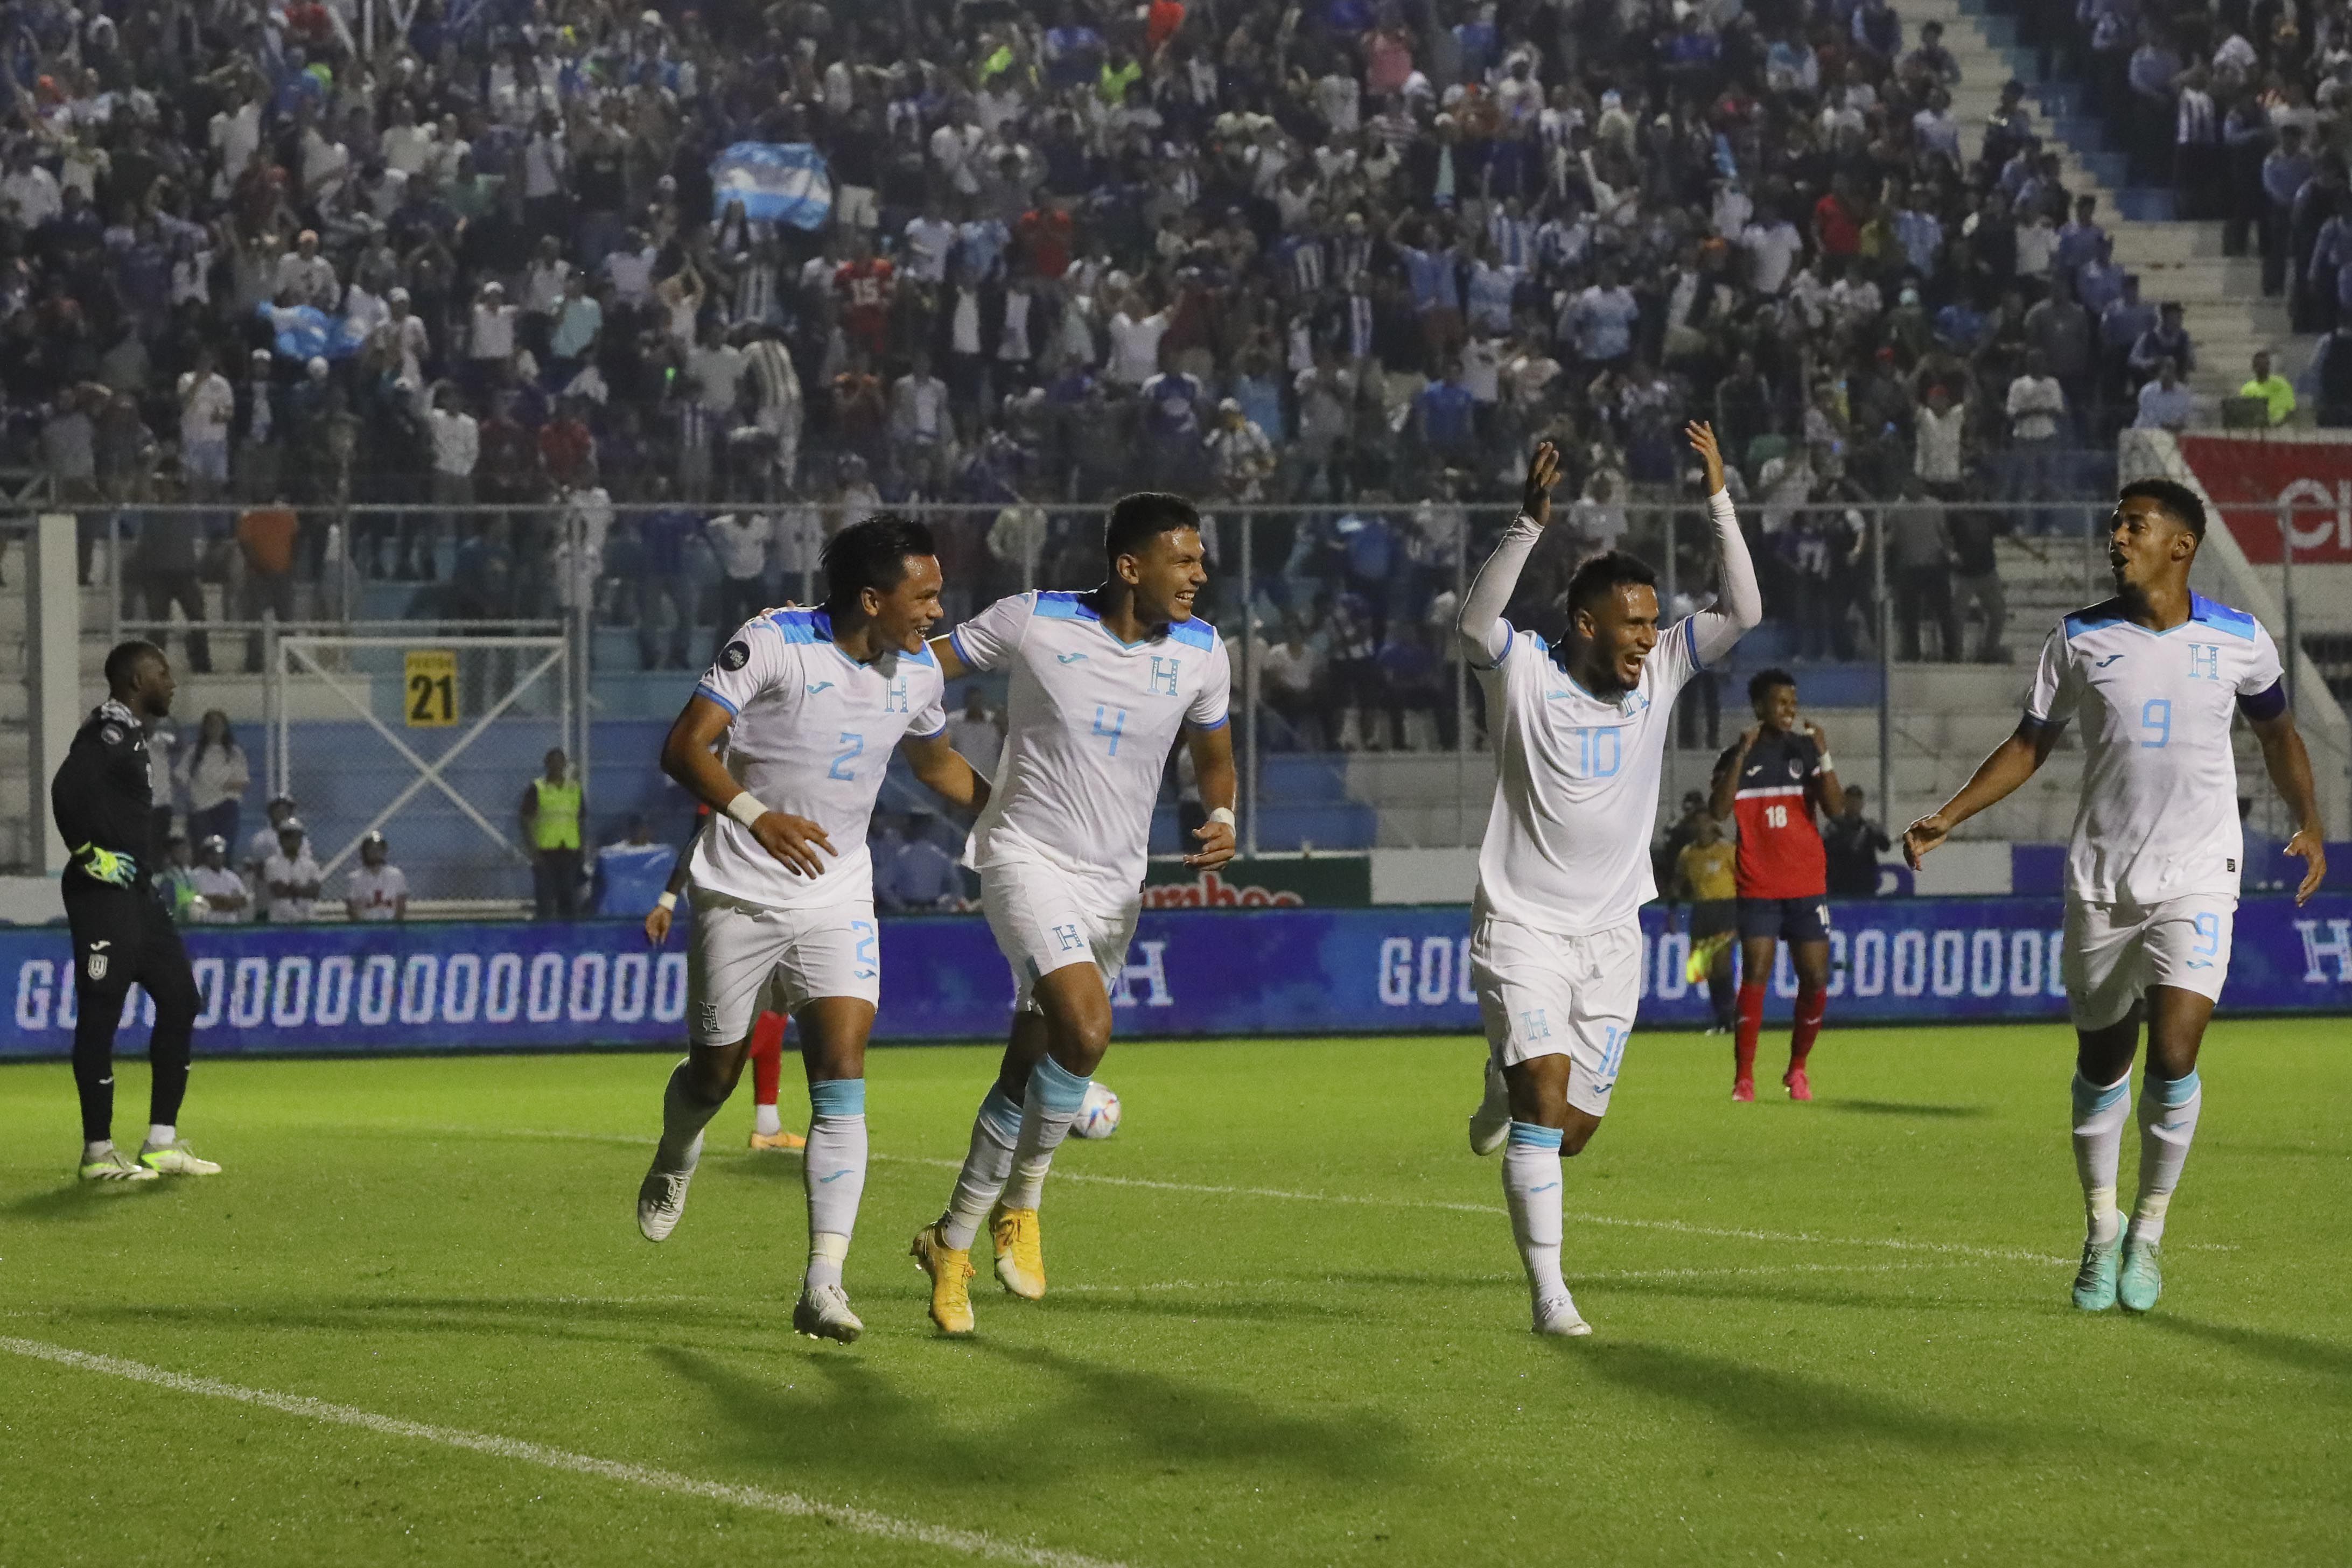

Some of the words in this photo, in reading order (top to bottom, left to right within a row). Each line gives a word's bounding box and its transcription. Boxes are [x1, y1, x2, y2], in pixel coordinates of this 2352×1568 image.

[411, 674, 451, 720] 21
[1147, 655, 1181, 696] H
[1091, 705, 1125, 756] 4
[2141, 699, 2171, 747] 9
[828, 732, 863, 780] 2
[1576, 727, 1620, 777] 10
[1766, 805, 1787, 828] 18
[851, 921, 877, 965] 2
[2193, 912, 2218, 956] 9
[1598, 1026, 1632, 1077] 10
